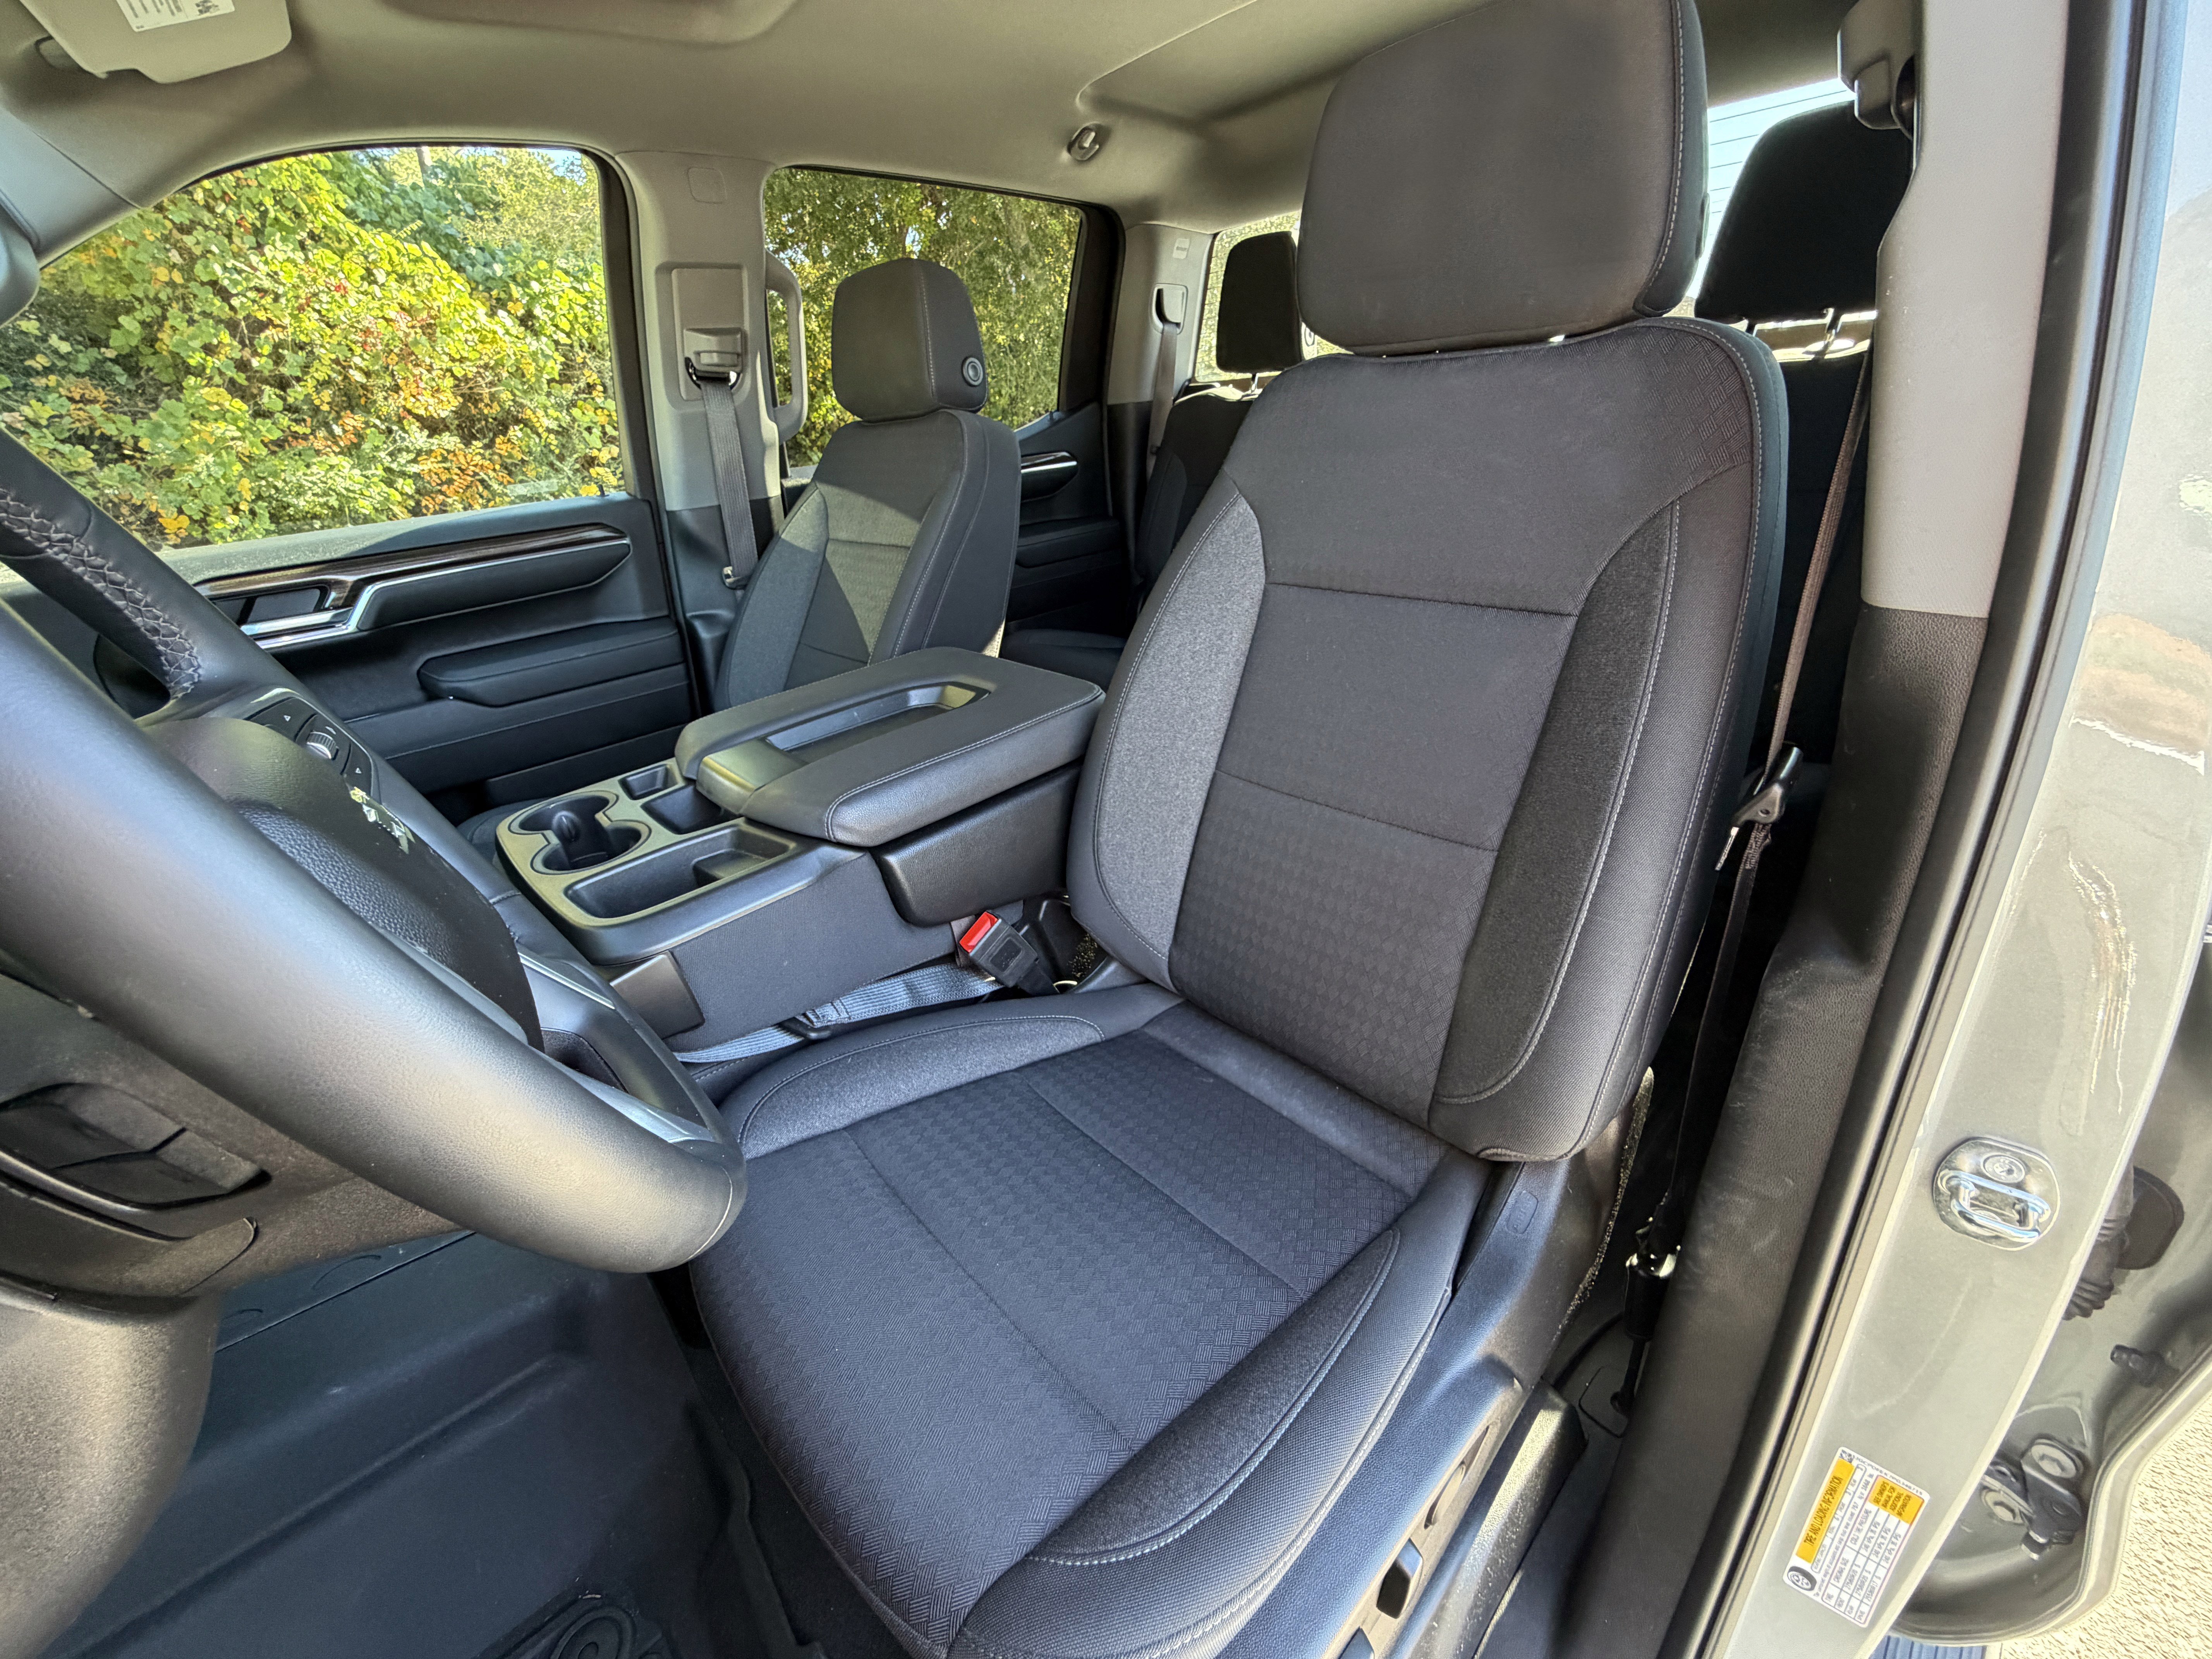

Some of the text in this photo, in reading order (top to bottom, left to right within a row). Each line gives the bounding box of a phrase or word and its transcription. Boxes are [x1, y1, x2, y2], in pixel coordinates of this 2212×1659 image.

[1821, 1474, 1843, 1507] INFORMATION
[1812, 1502, 1830, 1526] LOADING
[1808, 1523, 1821, 1536] AND
[1803, 1532, 1817, 1547] TIRE
